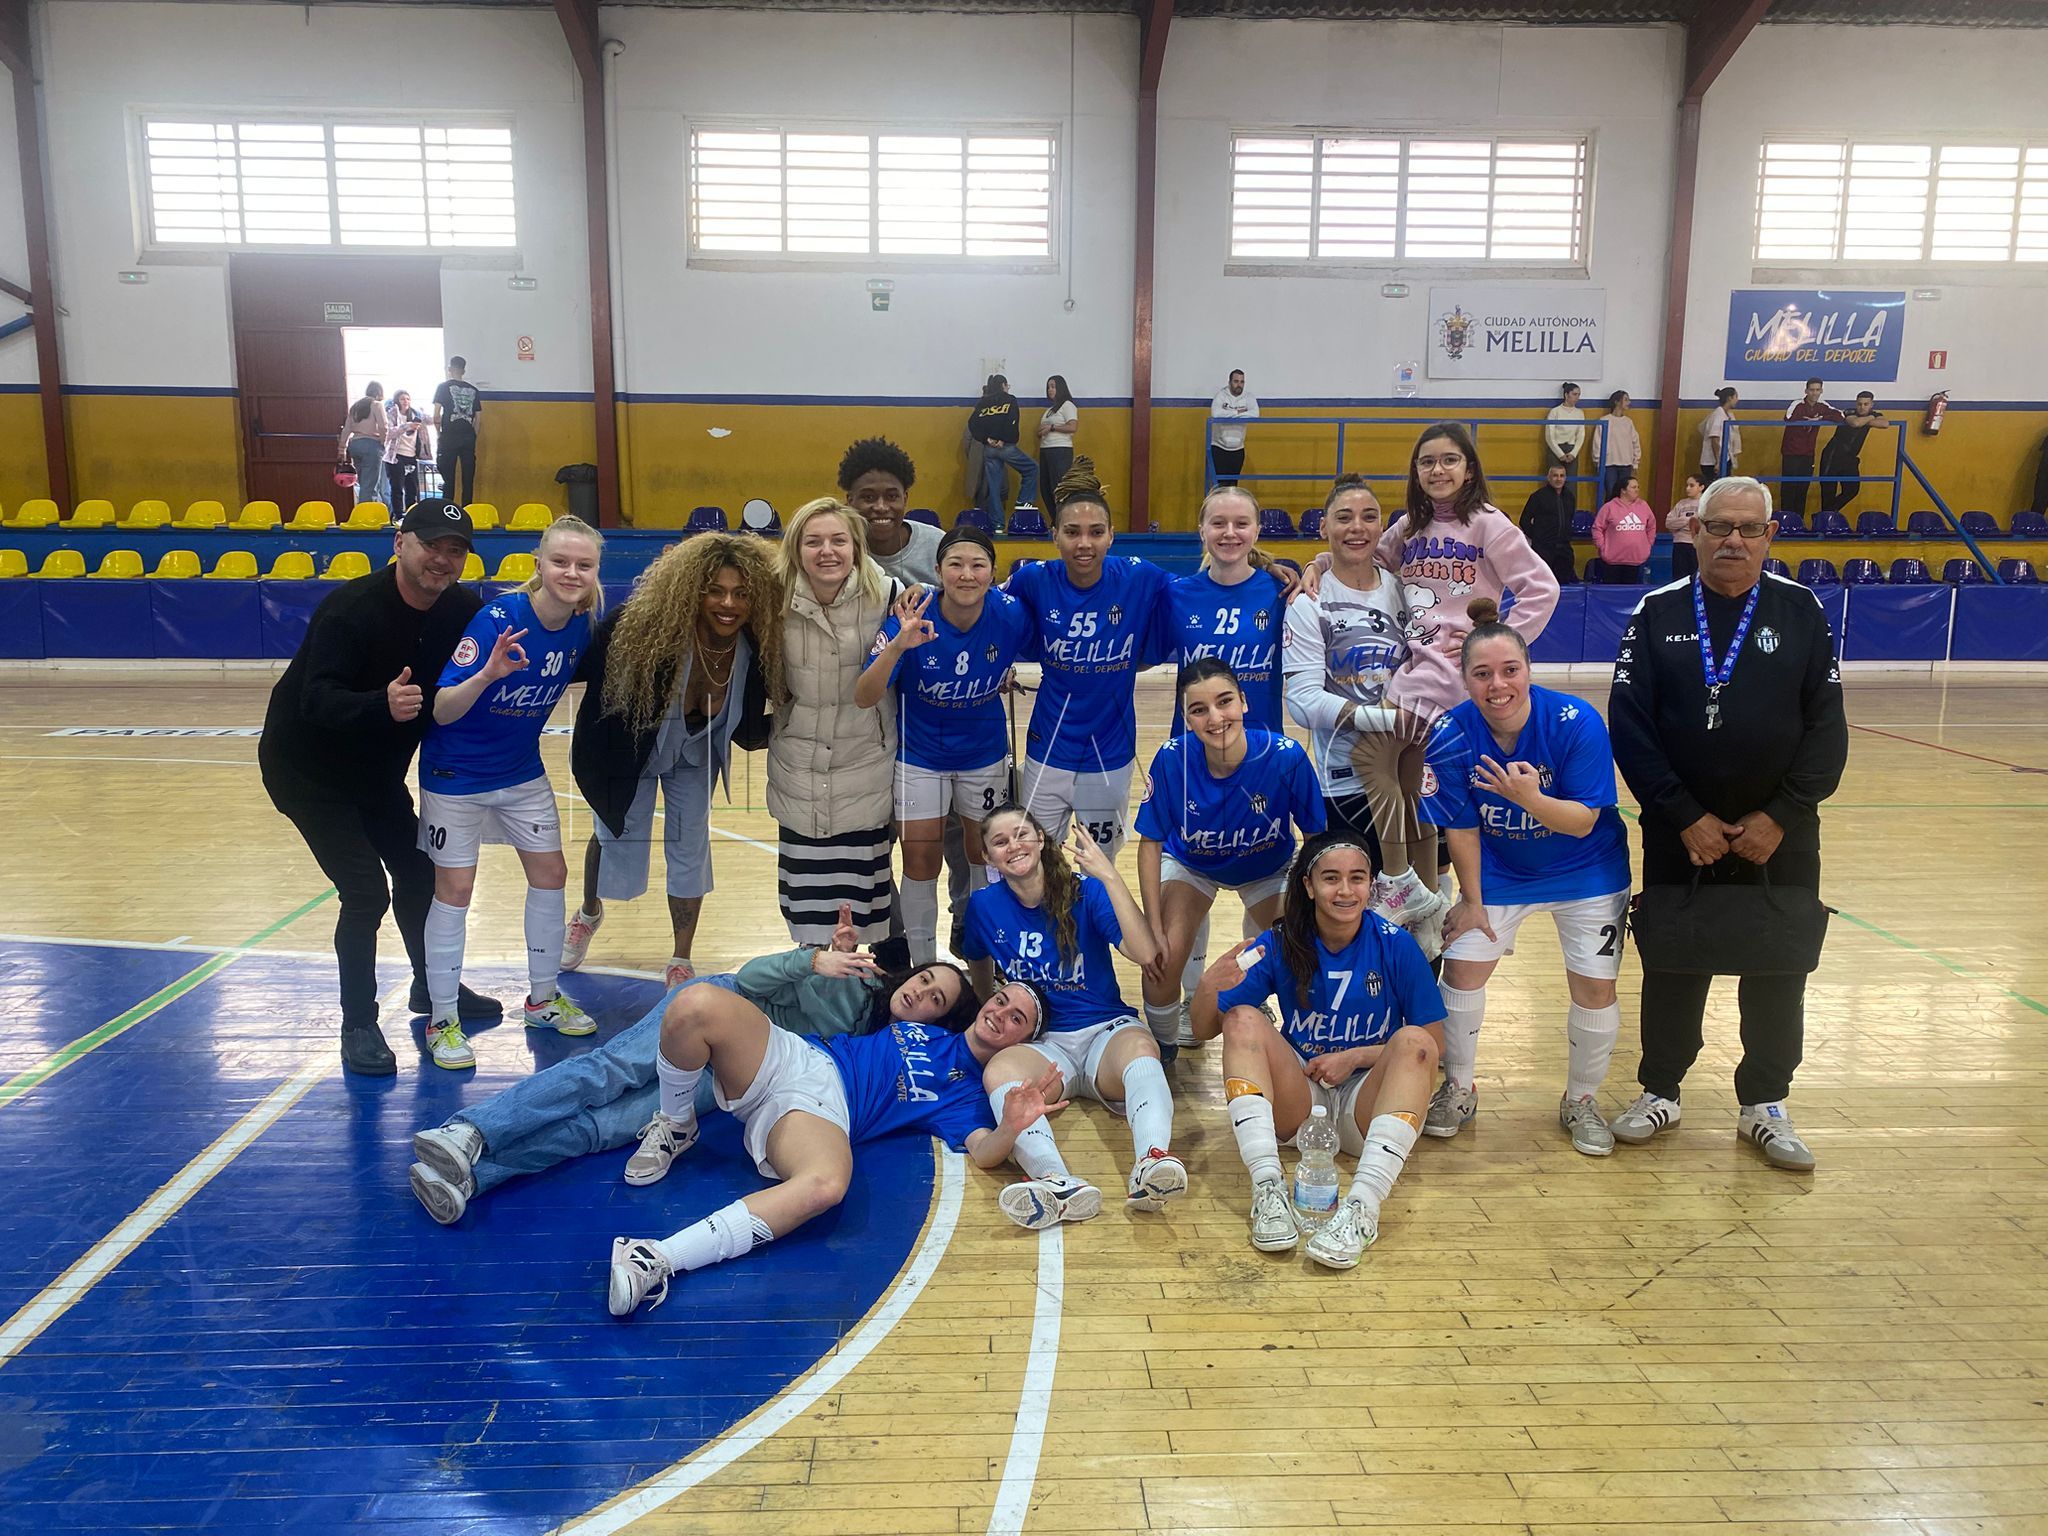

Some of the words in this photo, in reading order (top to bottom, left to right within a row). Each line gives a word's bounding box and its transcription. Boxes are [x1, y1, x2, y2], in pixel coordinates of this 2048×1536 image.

[327, 304, 350, 314] SALIDA
[1484, 317, 1526, 327] CIUDAD
[1529, 315, 1597, 327] AUTÓNOMA
[1745, 309, 1888, 347] MELILLA
[1486, 331, 1596, 353] MELILLA
[1745, 348, 1793, 362] CIUDAD
[1796, 348, 1819, 362] DEL
[1824, 349, 1878, 363] DEPORTE
[1615, 523, 1646, 532] adidas
[1403, 560, 1450, 581] with
[1452, 561, 1476, 584] it
[1067, 611, 1098, 638] 55
[1213, 608, 1241, 635] 25
[1368, 609, 1385, 634] 3
[1043, 633, 1135, 663] MELILLA
[1665, 634, 1699, 643] KELM
[540, 651, 564, 677] 30
[954, 650, 970, 676] 8
[982, 787, 995, 810] 8
[428, 824, 447, 850] 30
[1180, 817, 1282, 850] MELILLA
[1508, 831, 1529, 840] DEL
[1018, 930, 1044, 958] 13
[1328, 970, 1353, 1011] 7
